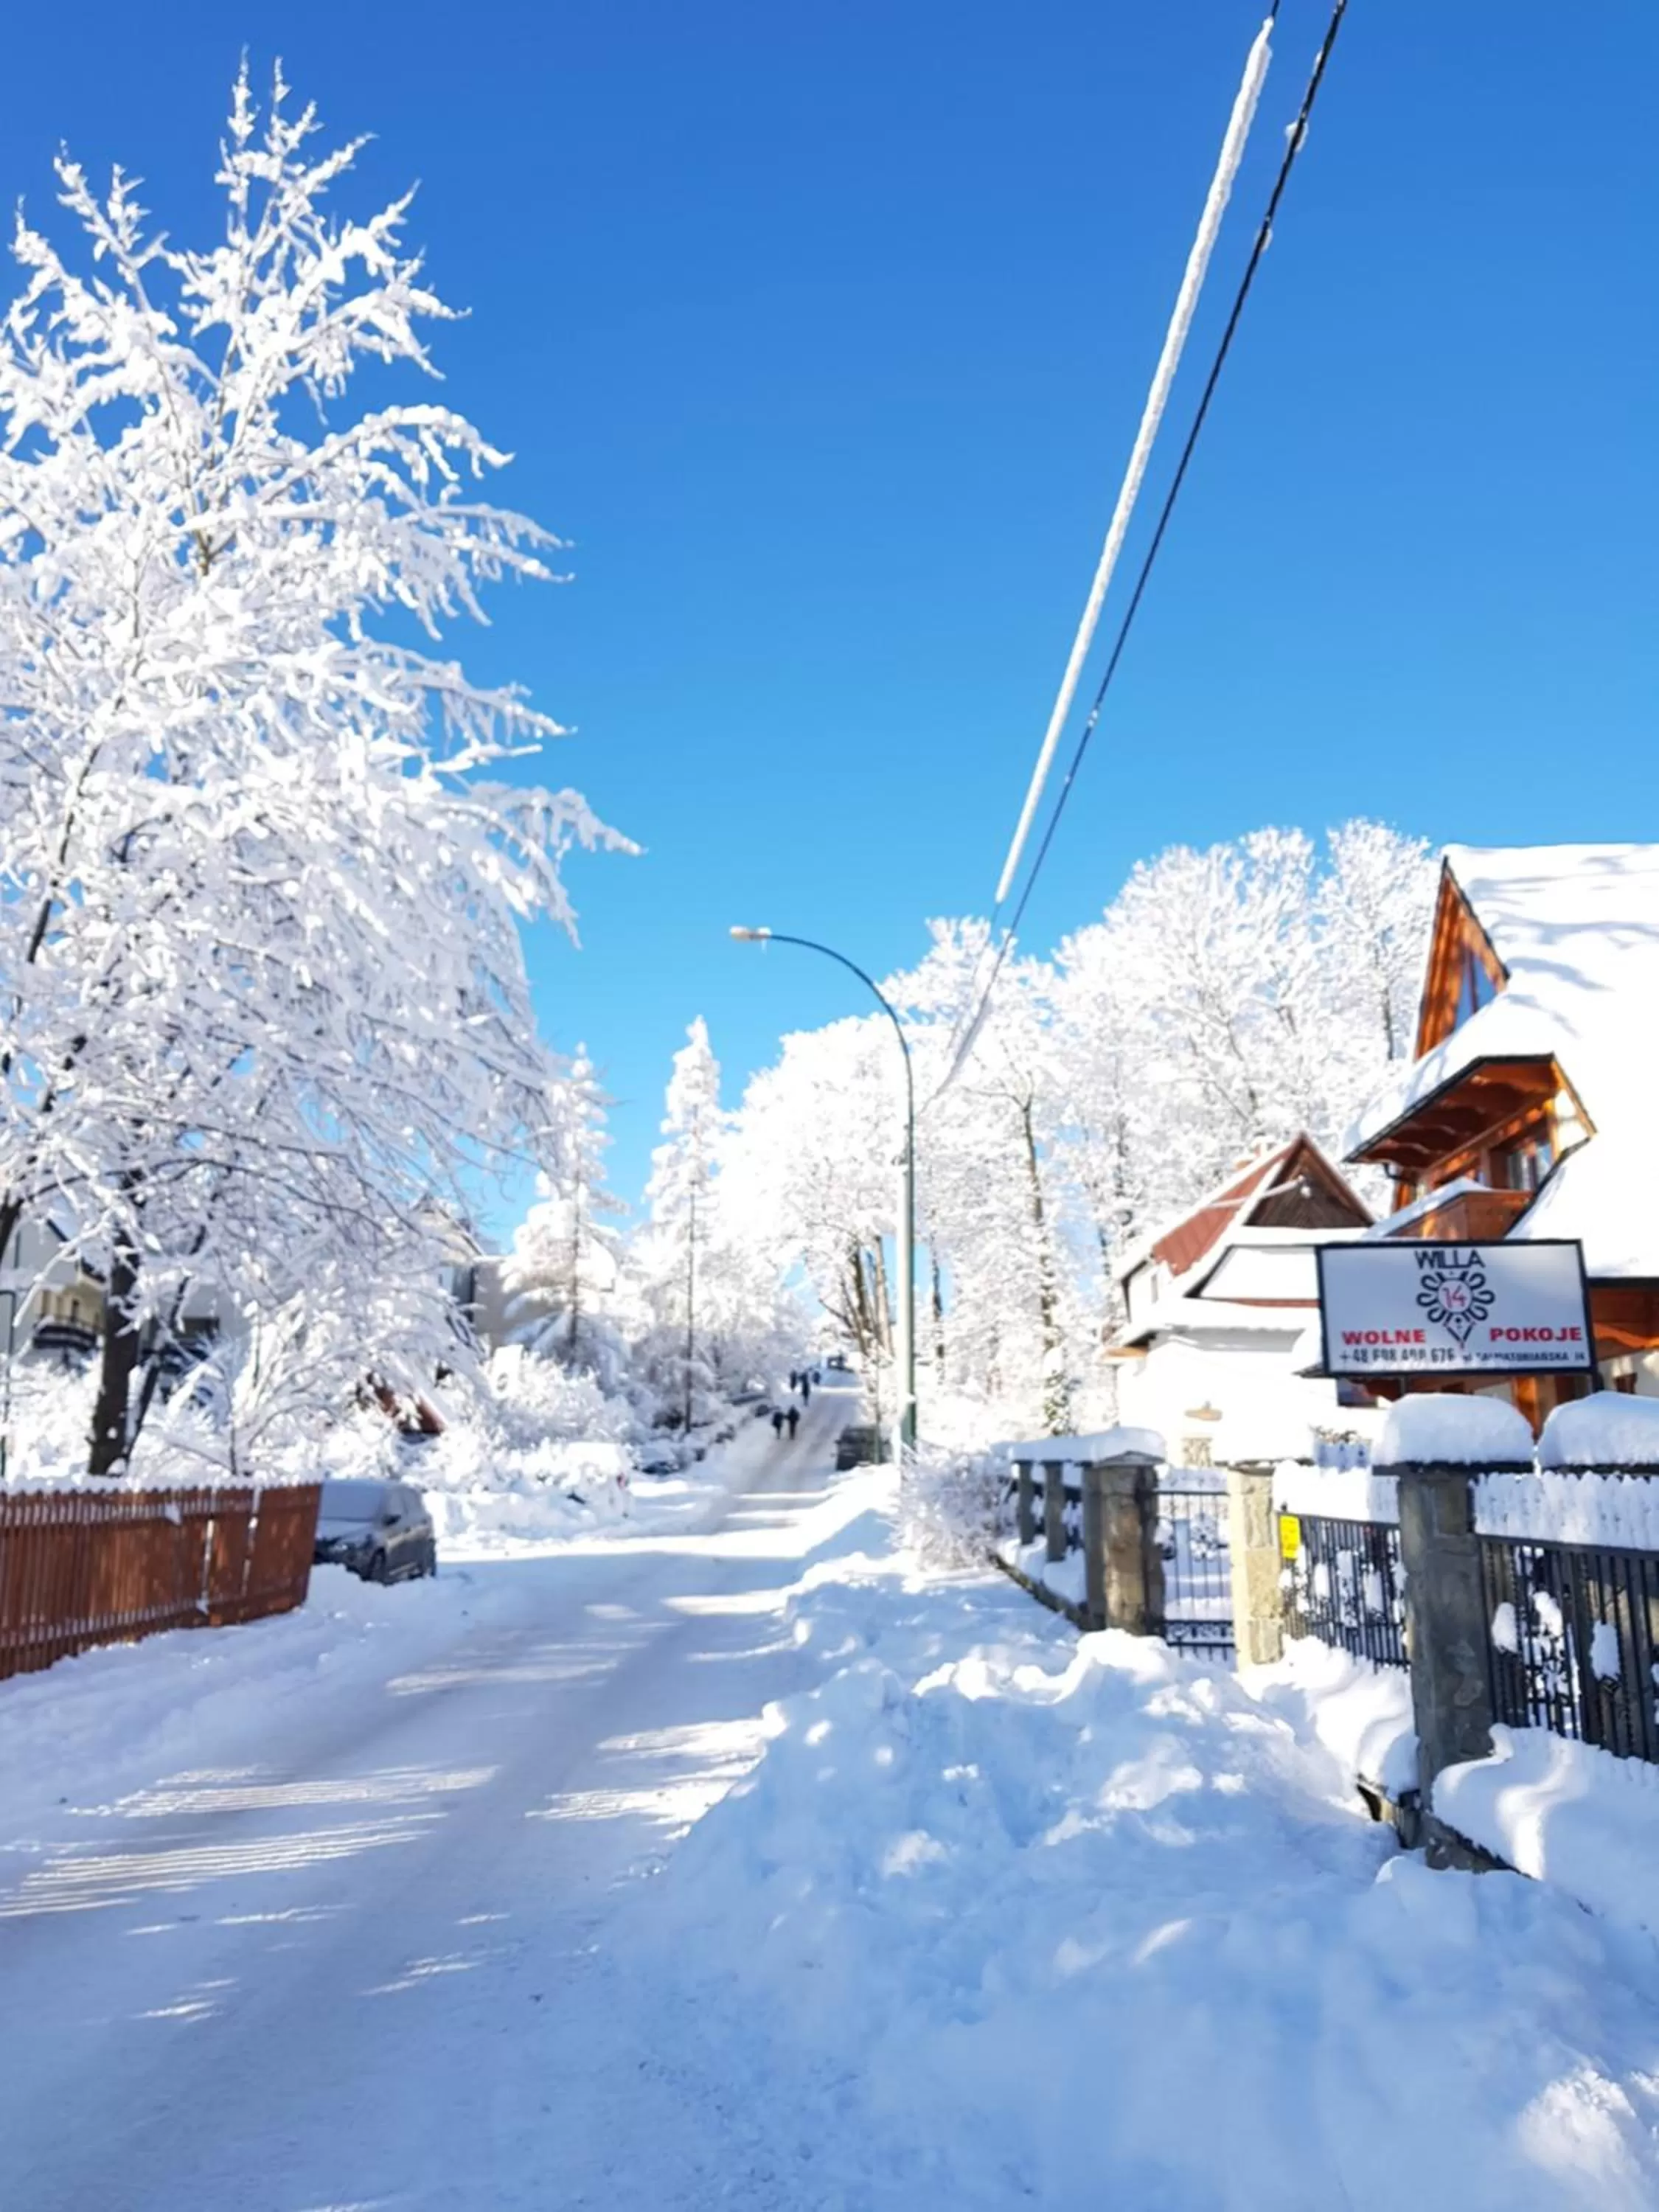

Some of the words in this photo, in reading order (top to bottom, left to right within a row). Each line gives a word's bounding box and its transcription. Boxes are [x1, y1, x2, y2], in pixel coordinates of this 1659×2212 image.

[1413, 1248, 1486, 1269] WILLA
[1441, 1285, 1467, 1309] 14
[1341, 1329, 1426, 1346] WOLNE
[1489, 1326, 1582, 1343] POKOJE
